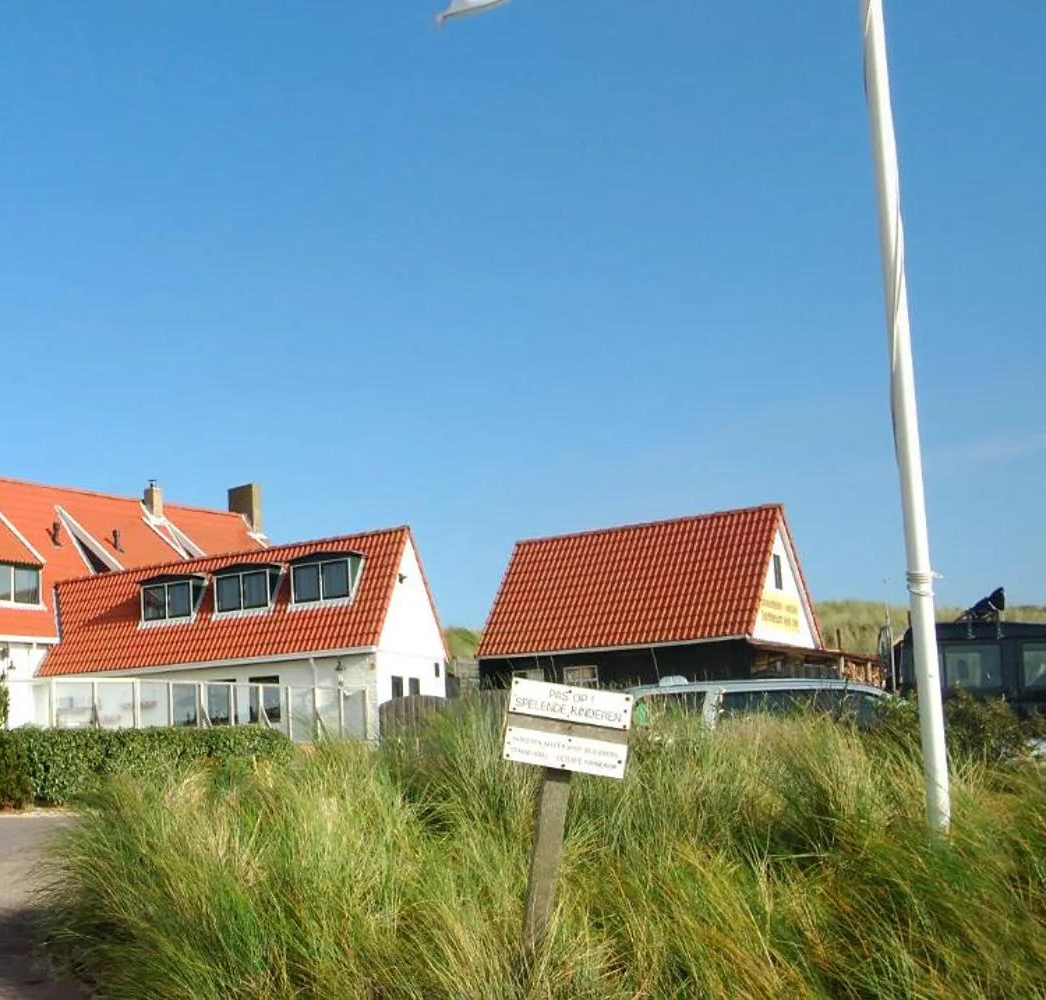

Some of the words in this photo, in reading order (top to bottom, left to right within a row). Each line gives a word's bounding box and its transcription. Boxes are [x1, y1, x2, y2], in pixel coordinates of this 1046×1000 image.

[549, 688, 569, 702] PAS
[515, 697, 567, 715] SPELENDE
[570, 705, 622, 722] KINDEREN
